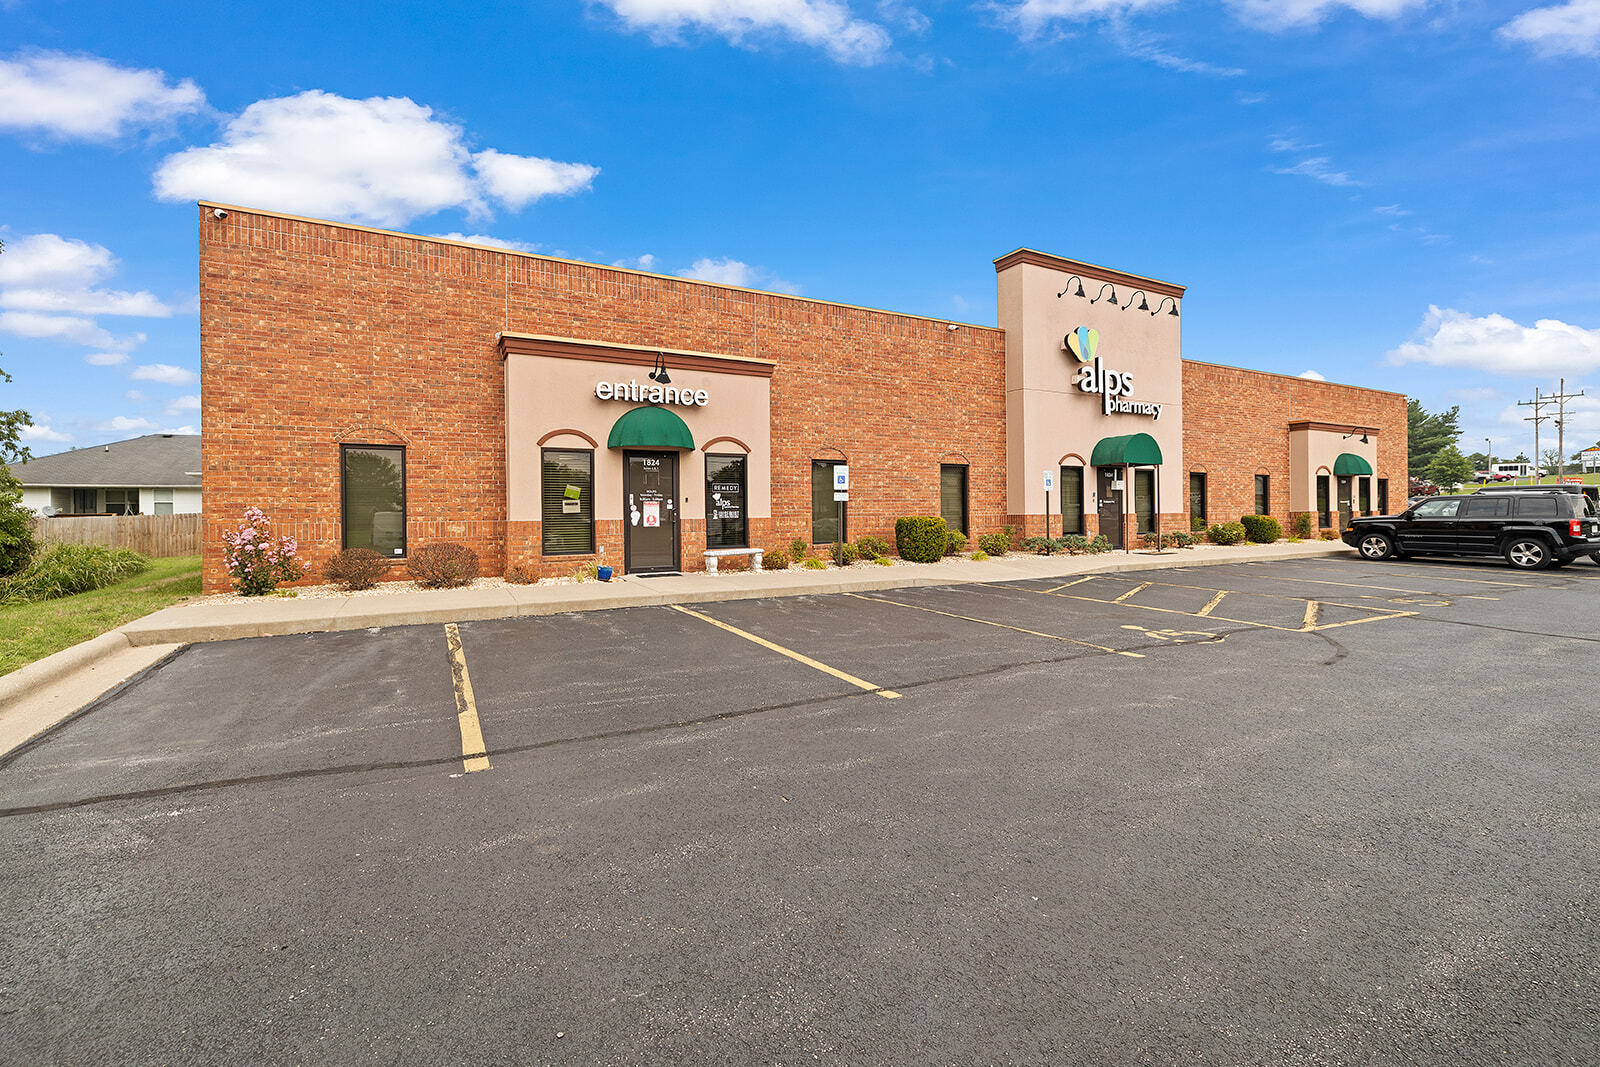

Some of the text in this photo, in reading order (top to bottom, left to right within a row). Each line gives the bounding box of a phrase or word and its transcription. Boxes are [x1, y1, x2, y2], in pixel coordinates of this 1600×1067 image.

[594, 380, 709, 407] entrance
[1078, 356, 1135, 416] alps
[1108, 396, 1162, 421] pharmacy
[715, 498, 731, 510] alps
